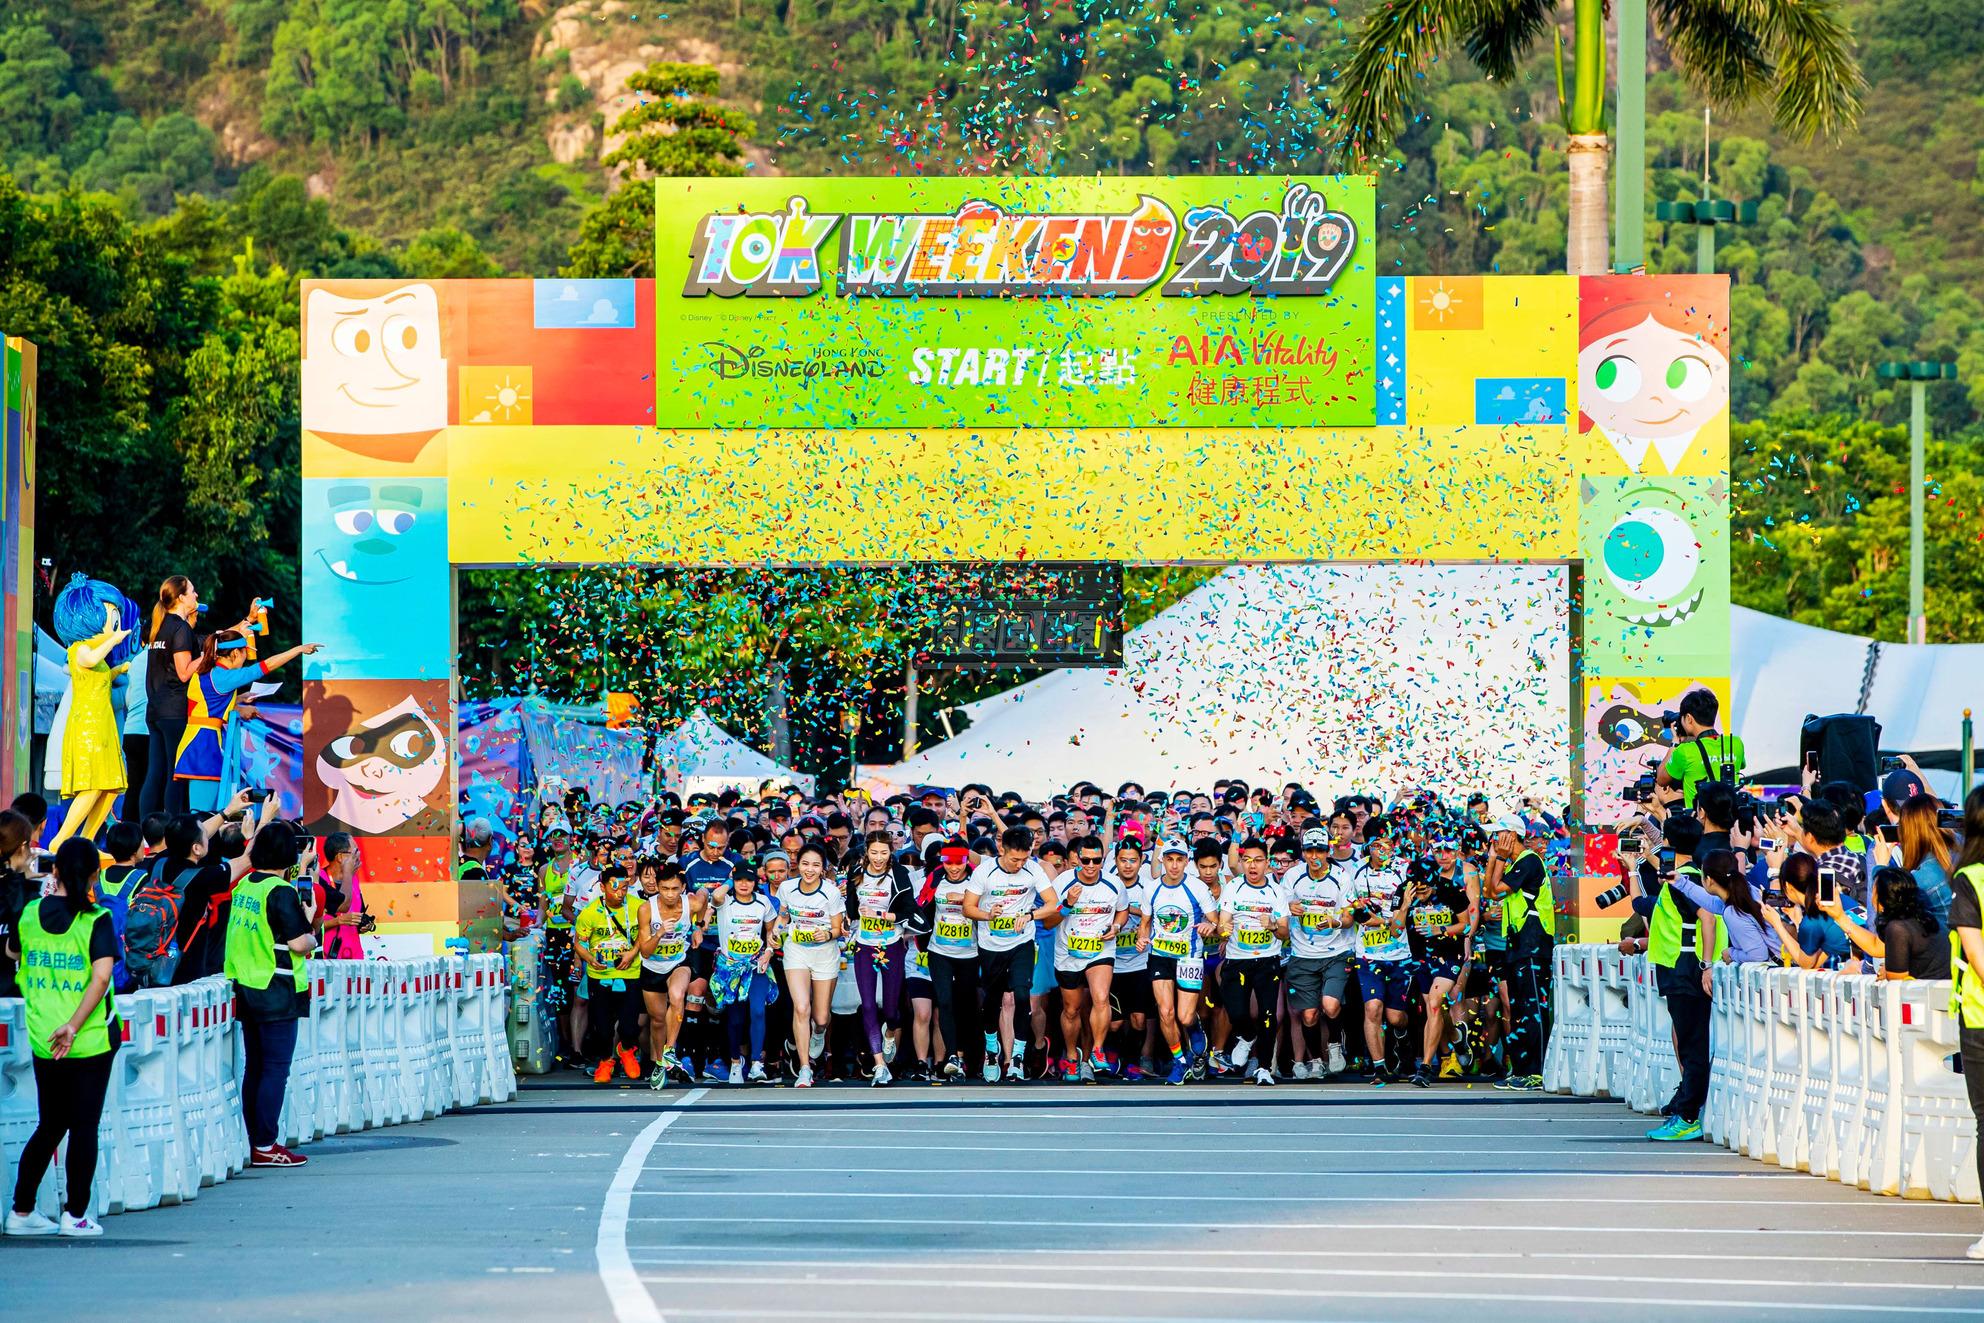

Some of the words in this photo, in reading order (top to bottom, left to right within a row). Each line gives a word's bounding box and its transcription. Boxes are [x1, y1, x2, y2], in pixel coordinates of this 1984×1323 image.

[696, 204, 842, 285] 10K
[846, 202, 1174, 285] WEEKEND
[1172, 197, 1355, 284] 2019
[1167, 334, 1244, 366] AIA
[1252, 329, 1339, 376] Vitality
[908, 347, 1035, 386] START
[1188, 375, 1314, 407] 健康程式
[861, 918, 892, 931] Y2694
[1415, 914, 1450, 926] Y582
[939, 923, 970, 938] Y2818
[1239, 930, 1271, 944] Y1235
[1070, 937, 1102, 951] Y2715
[1156, 939, 1188, 954] Y1698
[26, 949, 84, 971] 香港田總
